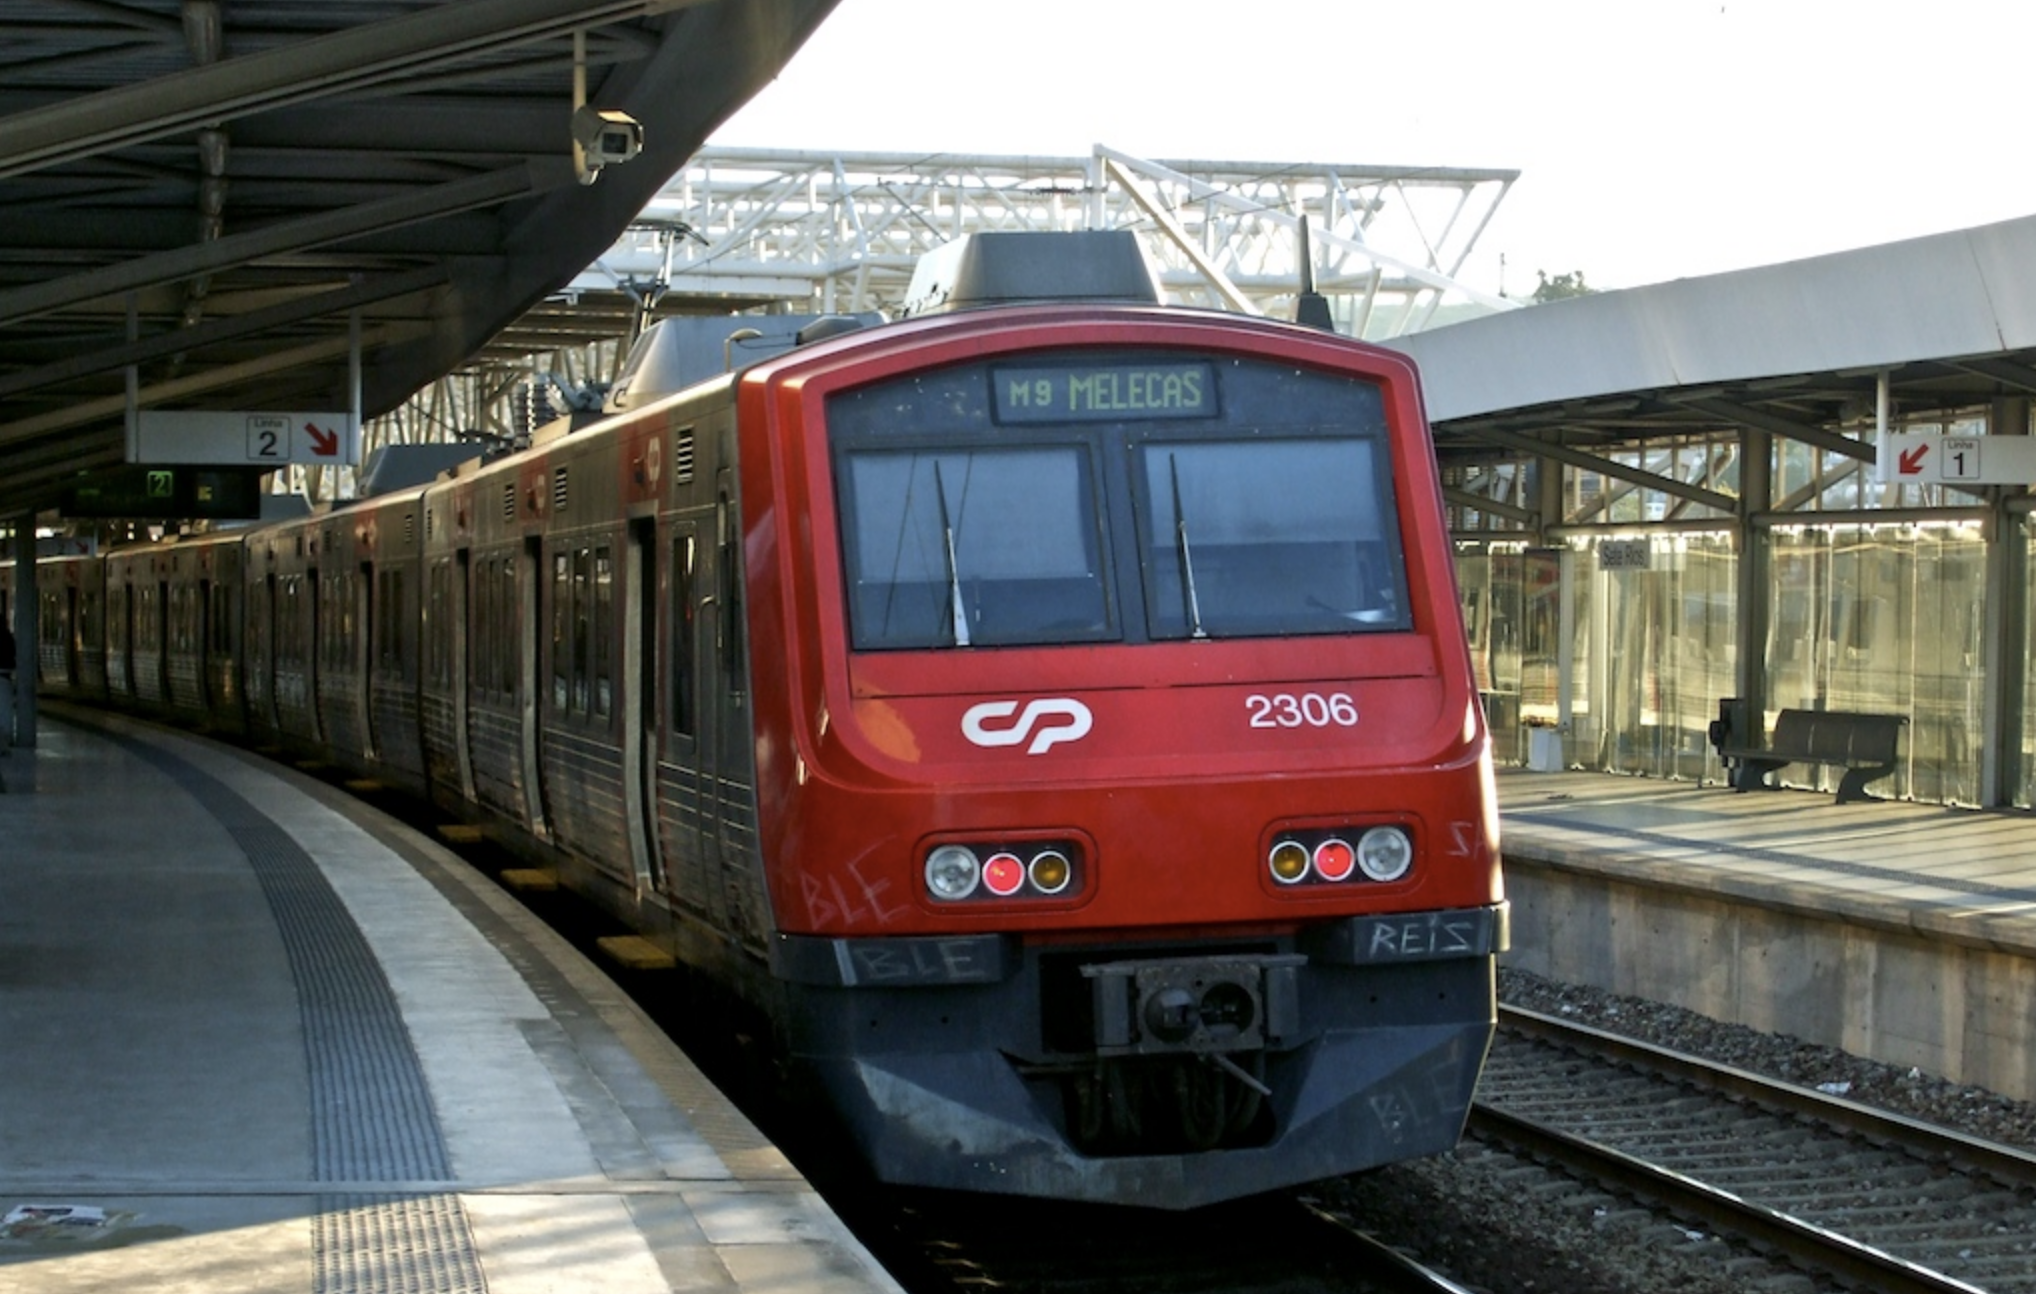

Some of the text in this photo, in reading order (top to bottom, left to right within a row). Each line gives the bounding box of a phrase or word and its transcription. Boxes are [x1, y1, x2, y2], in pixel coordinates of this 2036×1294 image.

[1009, 370, 1202, 411] M9 MELECAS
[254, 417, 283, 428] Linha
[259, 430, 277, 456] 2
[1947, 439, 1973, 450] Linha
[1953, 452, 1963, 476] 1
[1245, 692, 1359, 729] 2306
[961, 697, 1093, 755] CP
